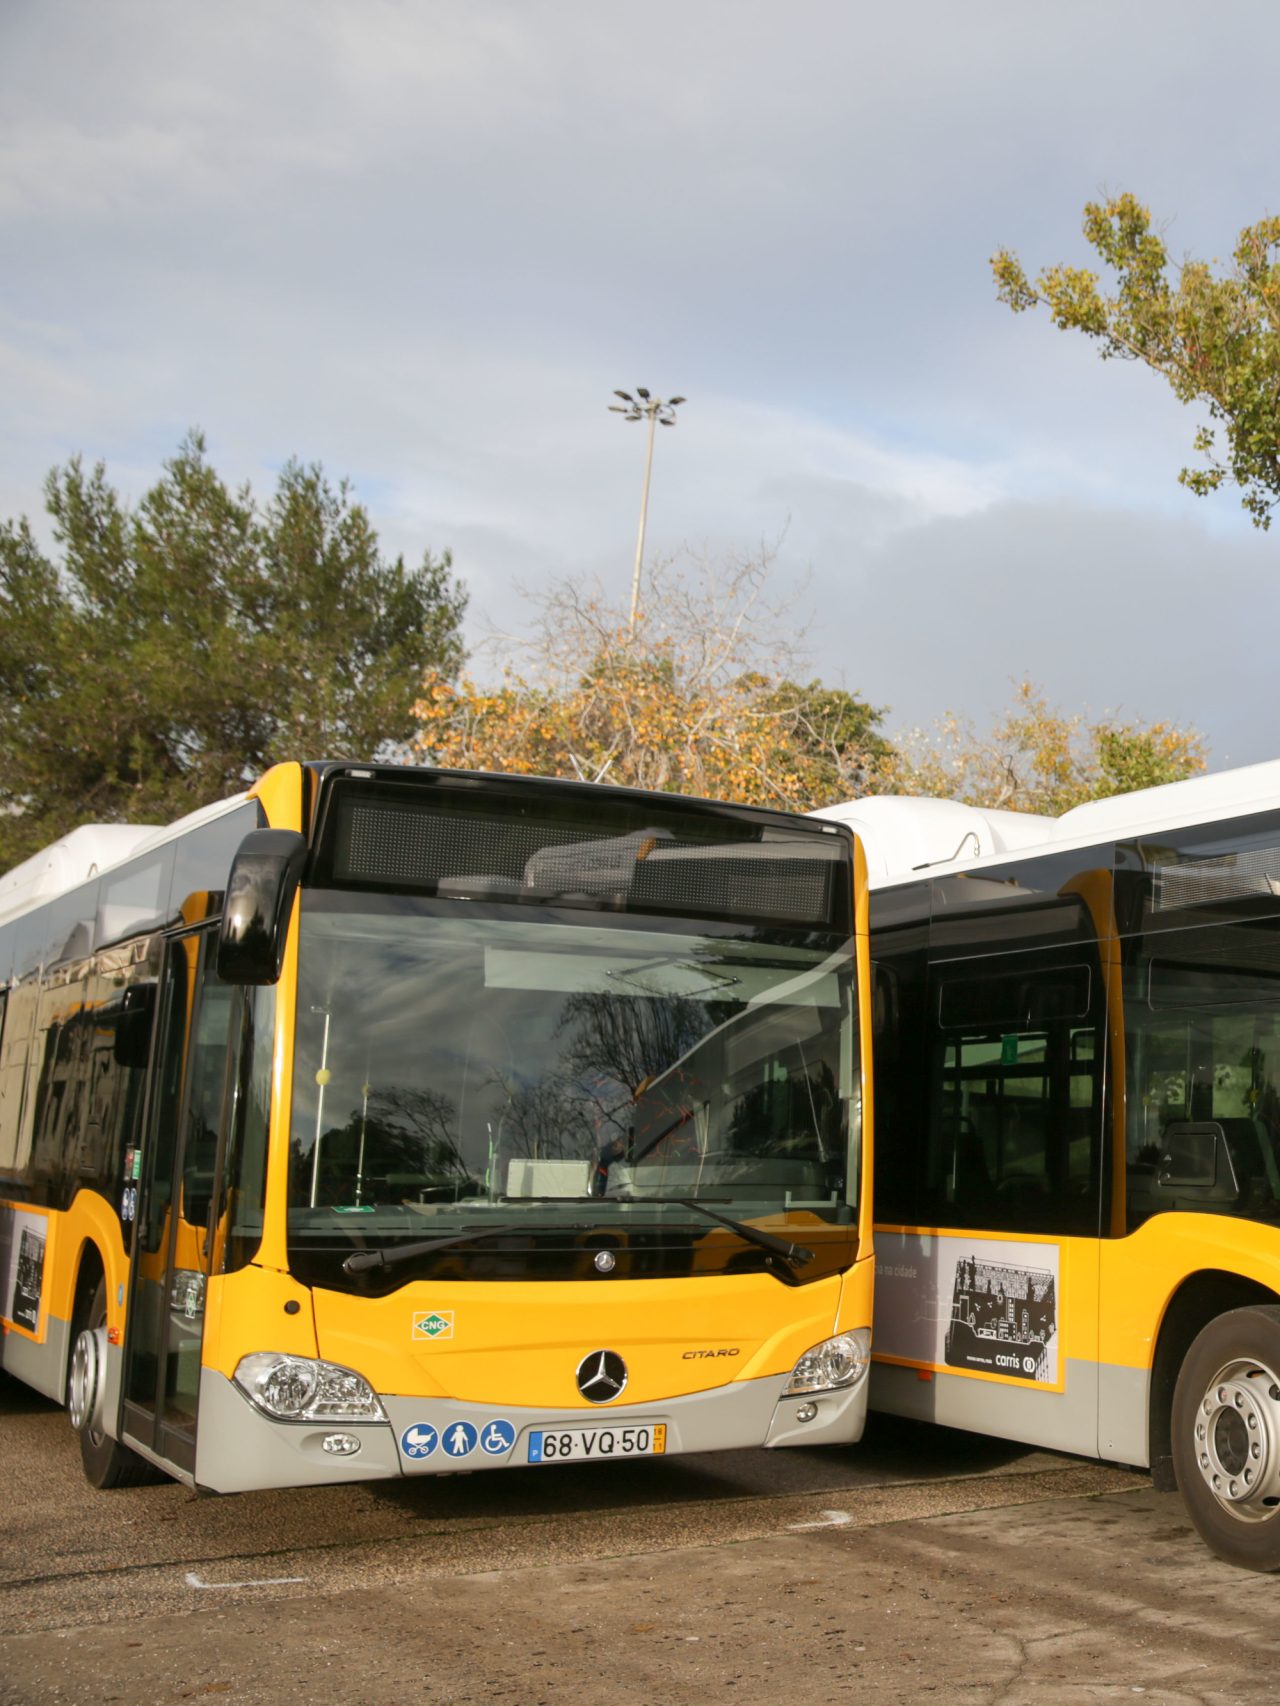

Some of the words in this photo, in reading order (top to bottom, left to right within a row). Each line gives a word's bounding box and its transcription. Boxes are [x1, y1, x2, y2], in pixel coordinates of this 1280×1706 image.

[421, 1320, 446, 1330] CNG
[682, 1347, 740, 1360] CITARO
[995, 1352, 1020, 1369] carris
